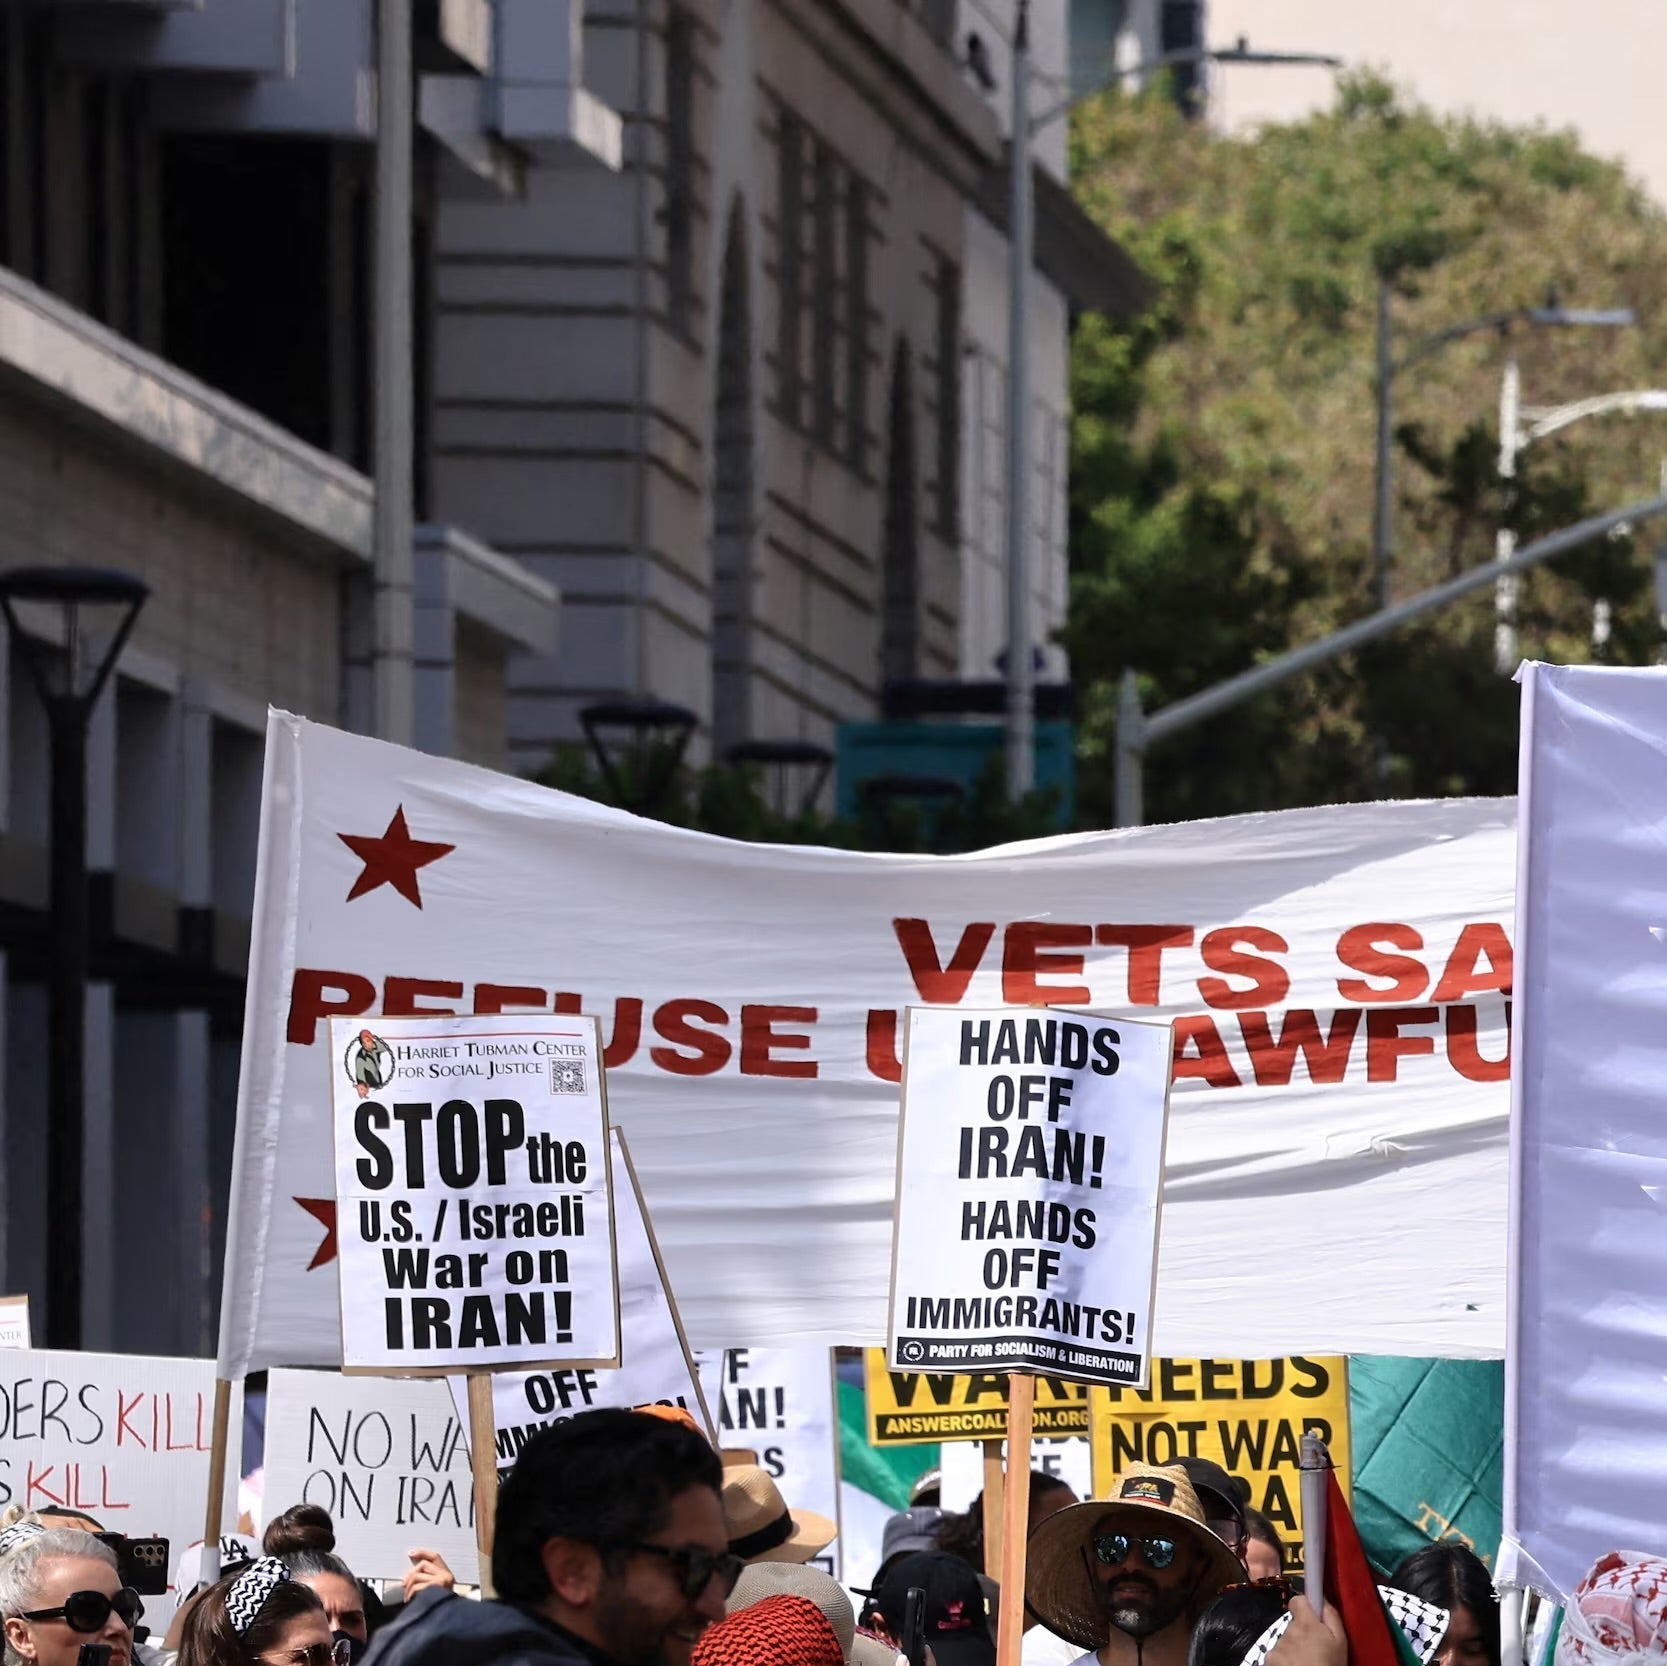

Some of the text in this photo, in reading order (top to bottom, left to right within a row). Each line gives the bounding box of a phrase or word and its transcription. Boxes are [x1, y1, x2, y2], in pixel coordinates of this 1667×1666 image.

[893, 918, 1289, 1008] VETS
[398, 1041, 587, 1060] HARRIET TUBMAN CENTER
[398, 1061, 543, 1080] FOR SOCIAL JUSTICE
[959, 1019, 1121, 1075] HANDS
[987, 1077, 1073, 1124] OFF
[354, 1099, 587, 1190] STOP the
[958, 1126, 1105, 1189] IRAN!
[360, 1195, 585, 1244] U.S. / Israeli
[960, 1200, 1097, 1250] HANDS
[383, 1248, 569, 1291] War on
[983, 1249, 1061, 1292] OFF
[385, 1291, 573, 1350] IRAN!
[906, 1297, 1137, 1346] IMMIGRANTS!
[929, 1345, 969, 1359] PARTY
[970, 1344, 993, 1358] FOR
[994, 1343, 1056, 1360] SOCIALISM
[1058, 1350, 1067, 1362] &
[1069, 1351, 1135, 1375] LIBERATION
[524, 1370, 599, 1416] OFF
[118, 1390, 213, 1452] KILL
[308, 1407, 392, 1470] NO
[1111, 1420, 1207, 1474] NOT
[26, 1460, 131, 1510] KILL
[303, 1470, 475, 1529] ON IRA
